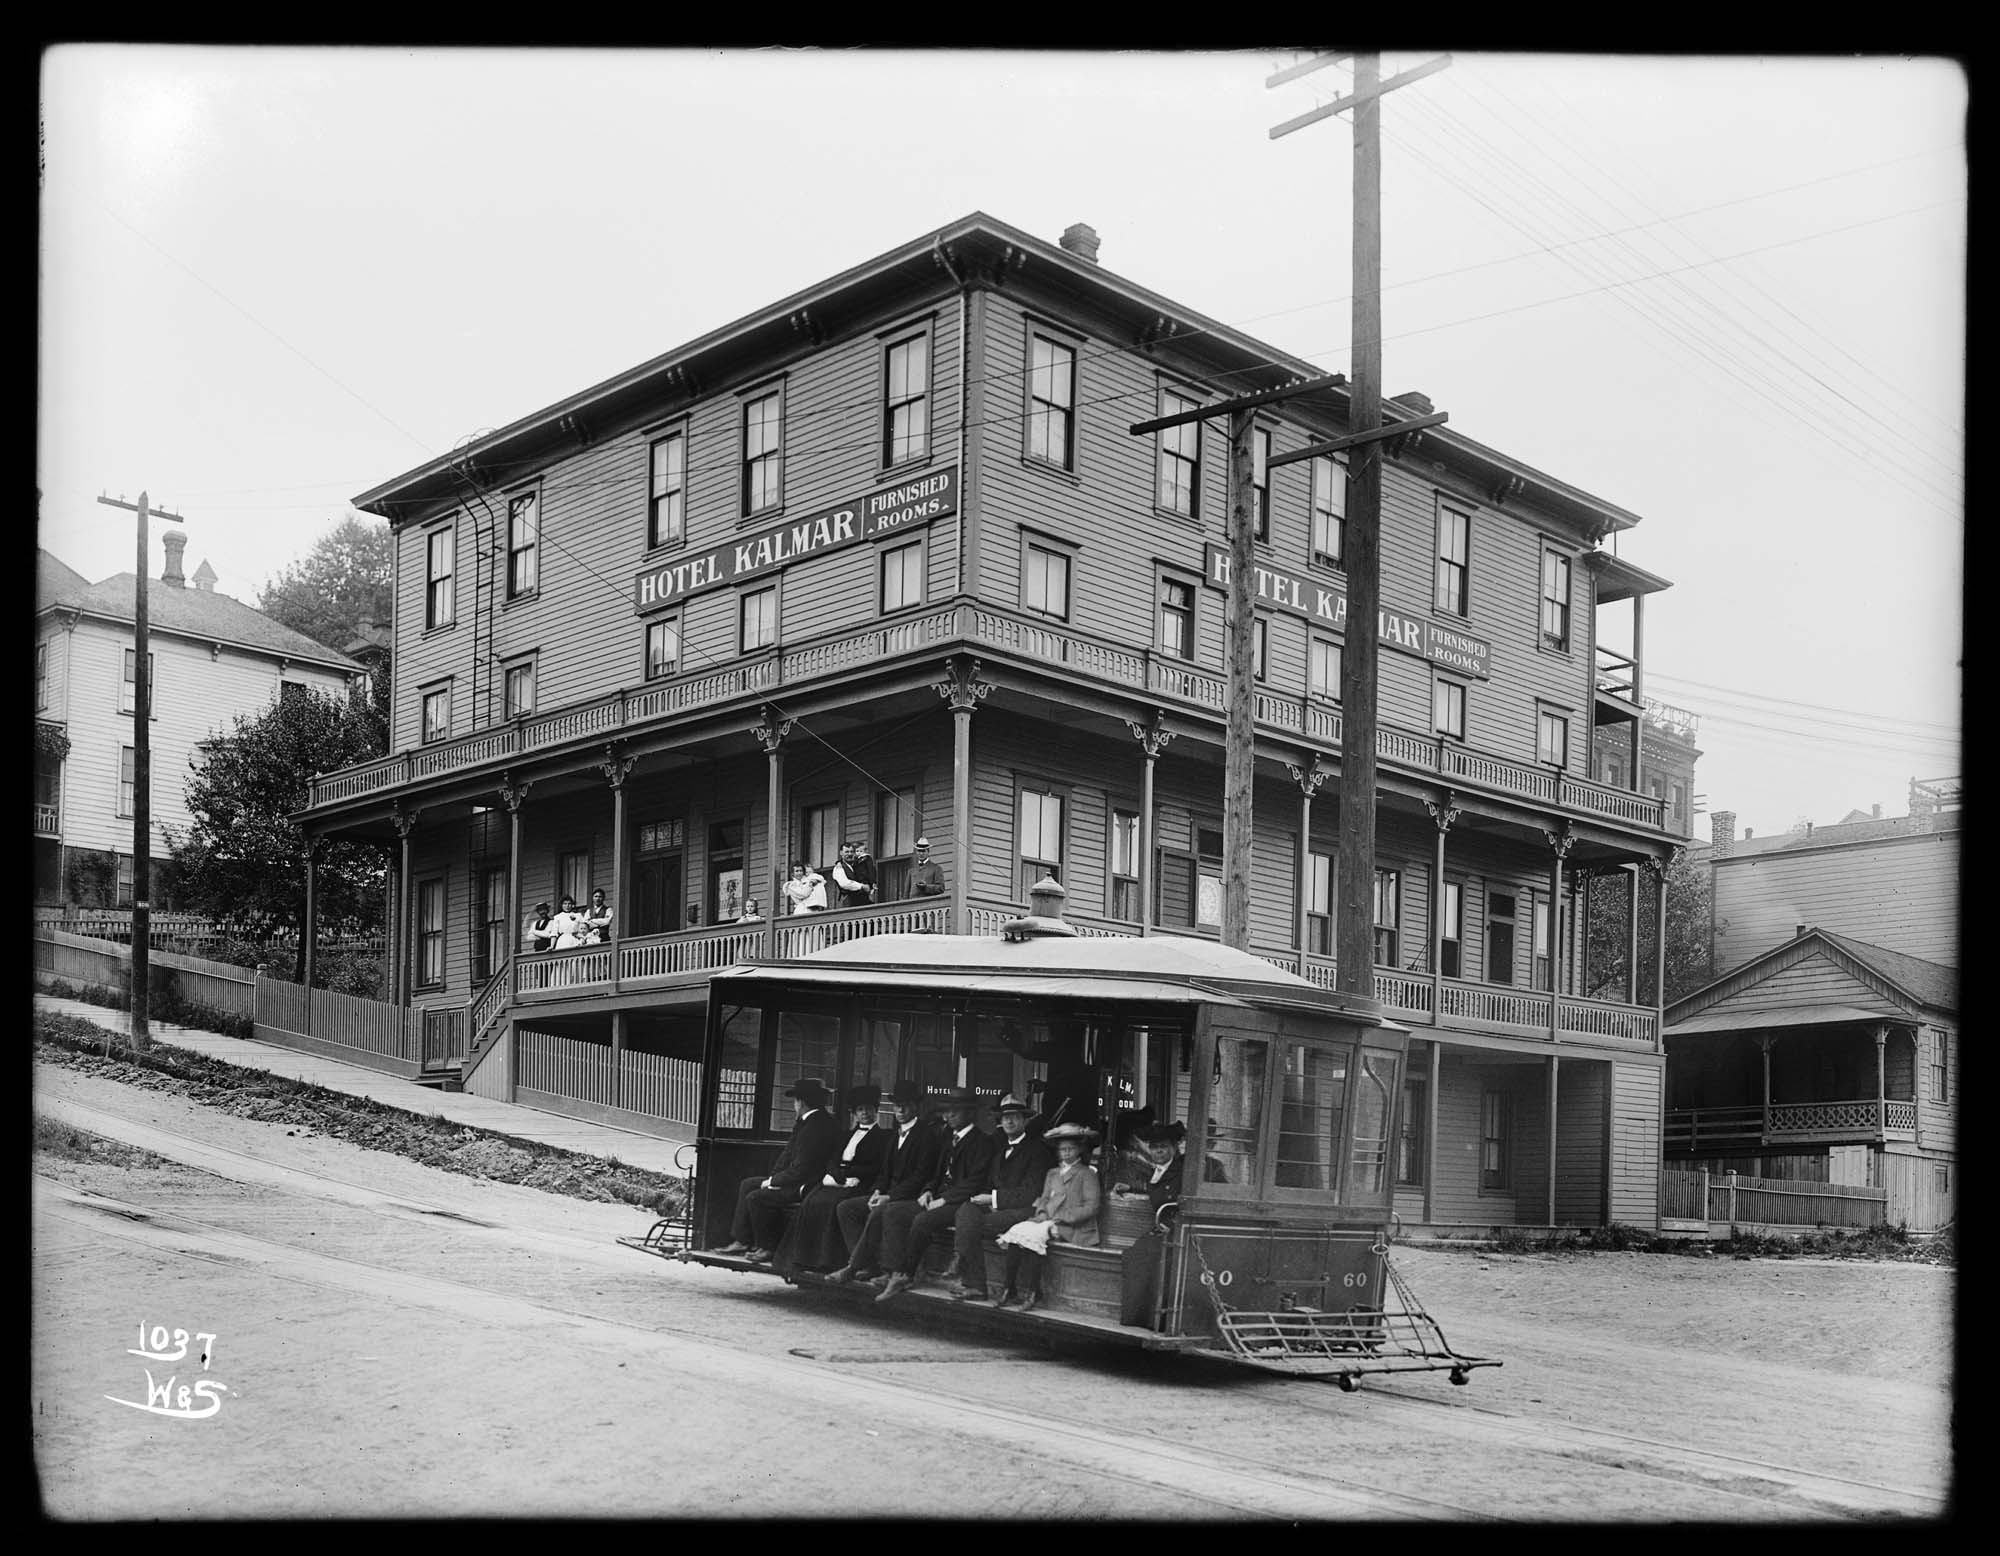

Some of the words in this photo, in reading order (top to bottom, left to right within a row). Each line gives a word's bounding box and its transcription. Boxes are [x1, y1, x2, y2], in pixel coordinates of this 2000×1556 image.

[871, 474, 949, 514] FURNISHED
[877, 498, 940, 531] ROOMS
[640, 555, 723, 605] HOTEL
[734, 510, 855, 575] KALMAR
[1213, 552, 1308, 611] HTEL
[1316, 589, 1421, 651] KAAR
[1431, 627, 1487, 658] FURNISHED
[1434, 646, 1480, 672] ROOMS
[1200, 1270, 1233, 1286] 60
[1343, 1272, 1368, 1288] 60
